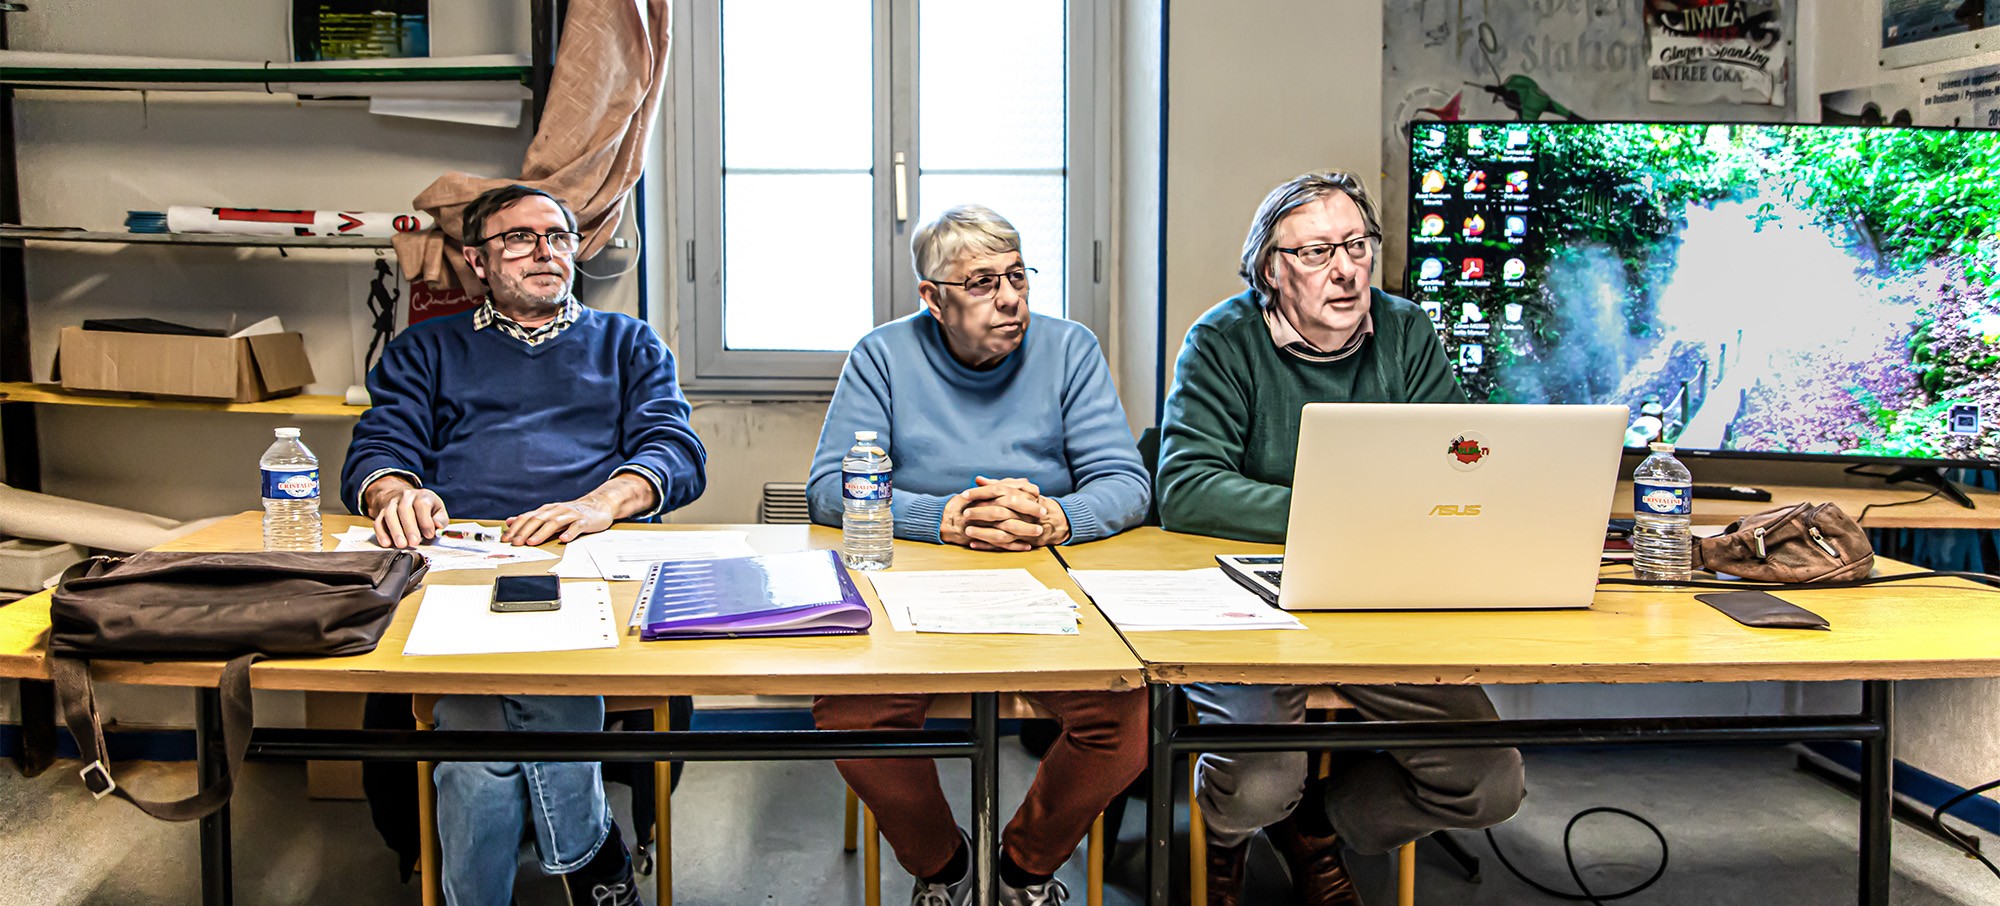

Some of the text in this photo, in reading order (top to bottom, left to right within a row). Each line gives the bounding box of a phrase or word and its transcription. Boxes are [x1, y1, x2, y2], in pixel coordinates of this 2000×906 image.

[1660, 45, 1770, 70] Ginger Spanking
[1428, 504, 1482, 516] ASUS
